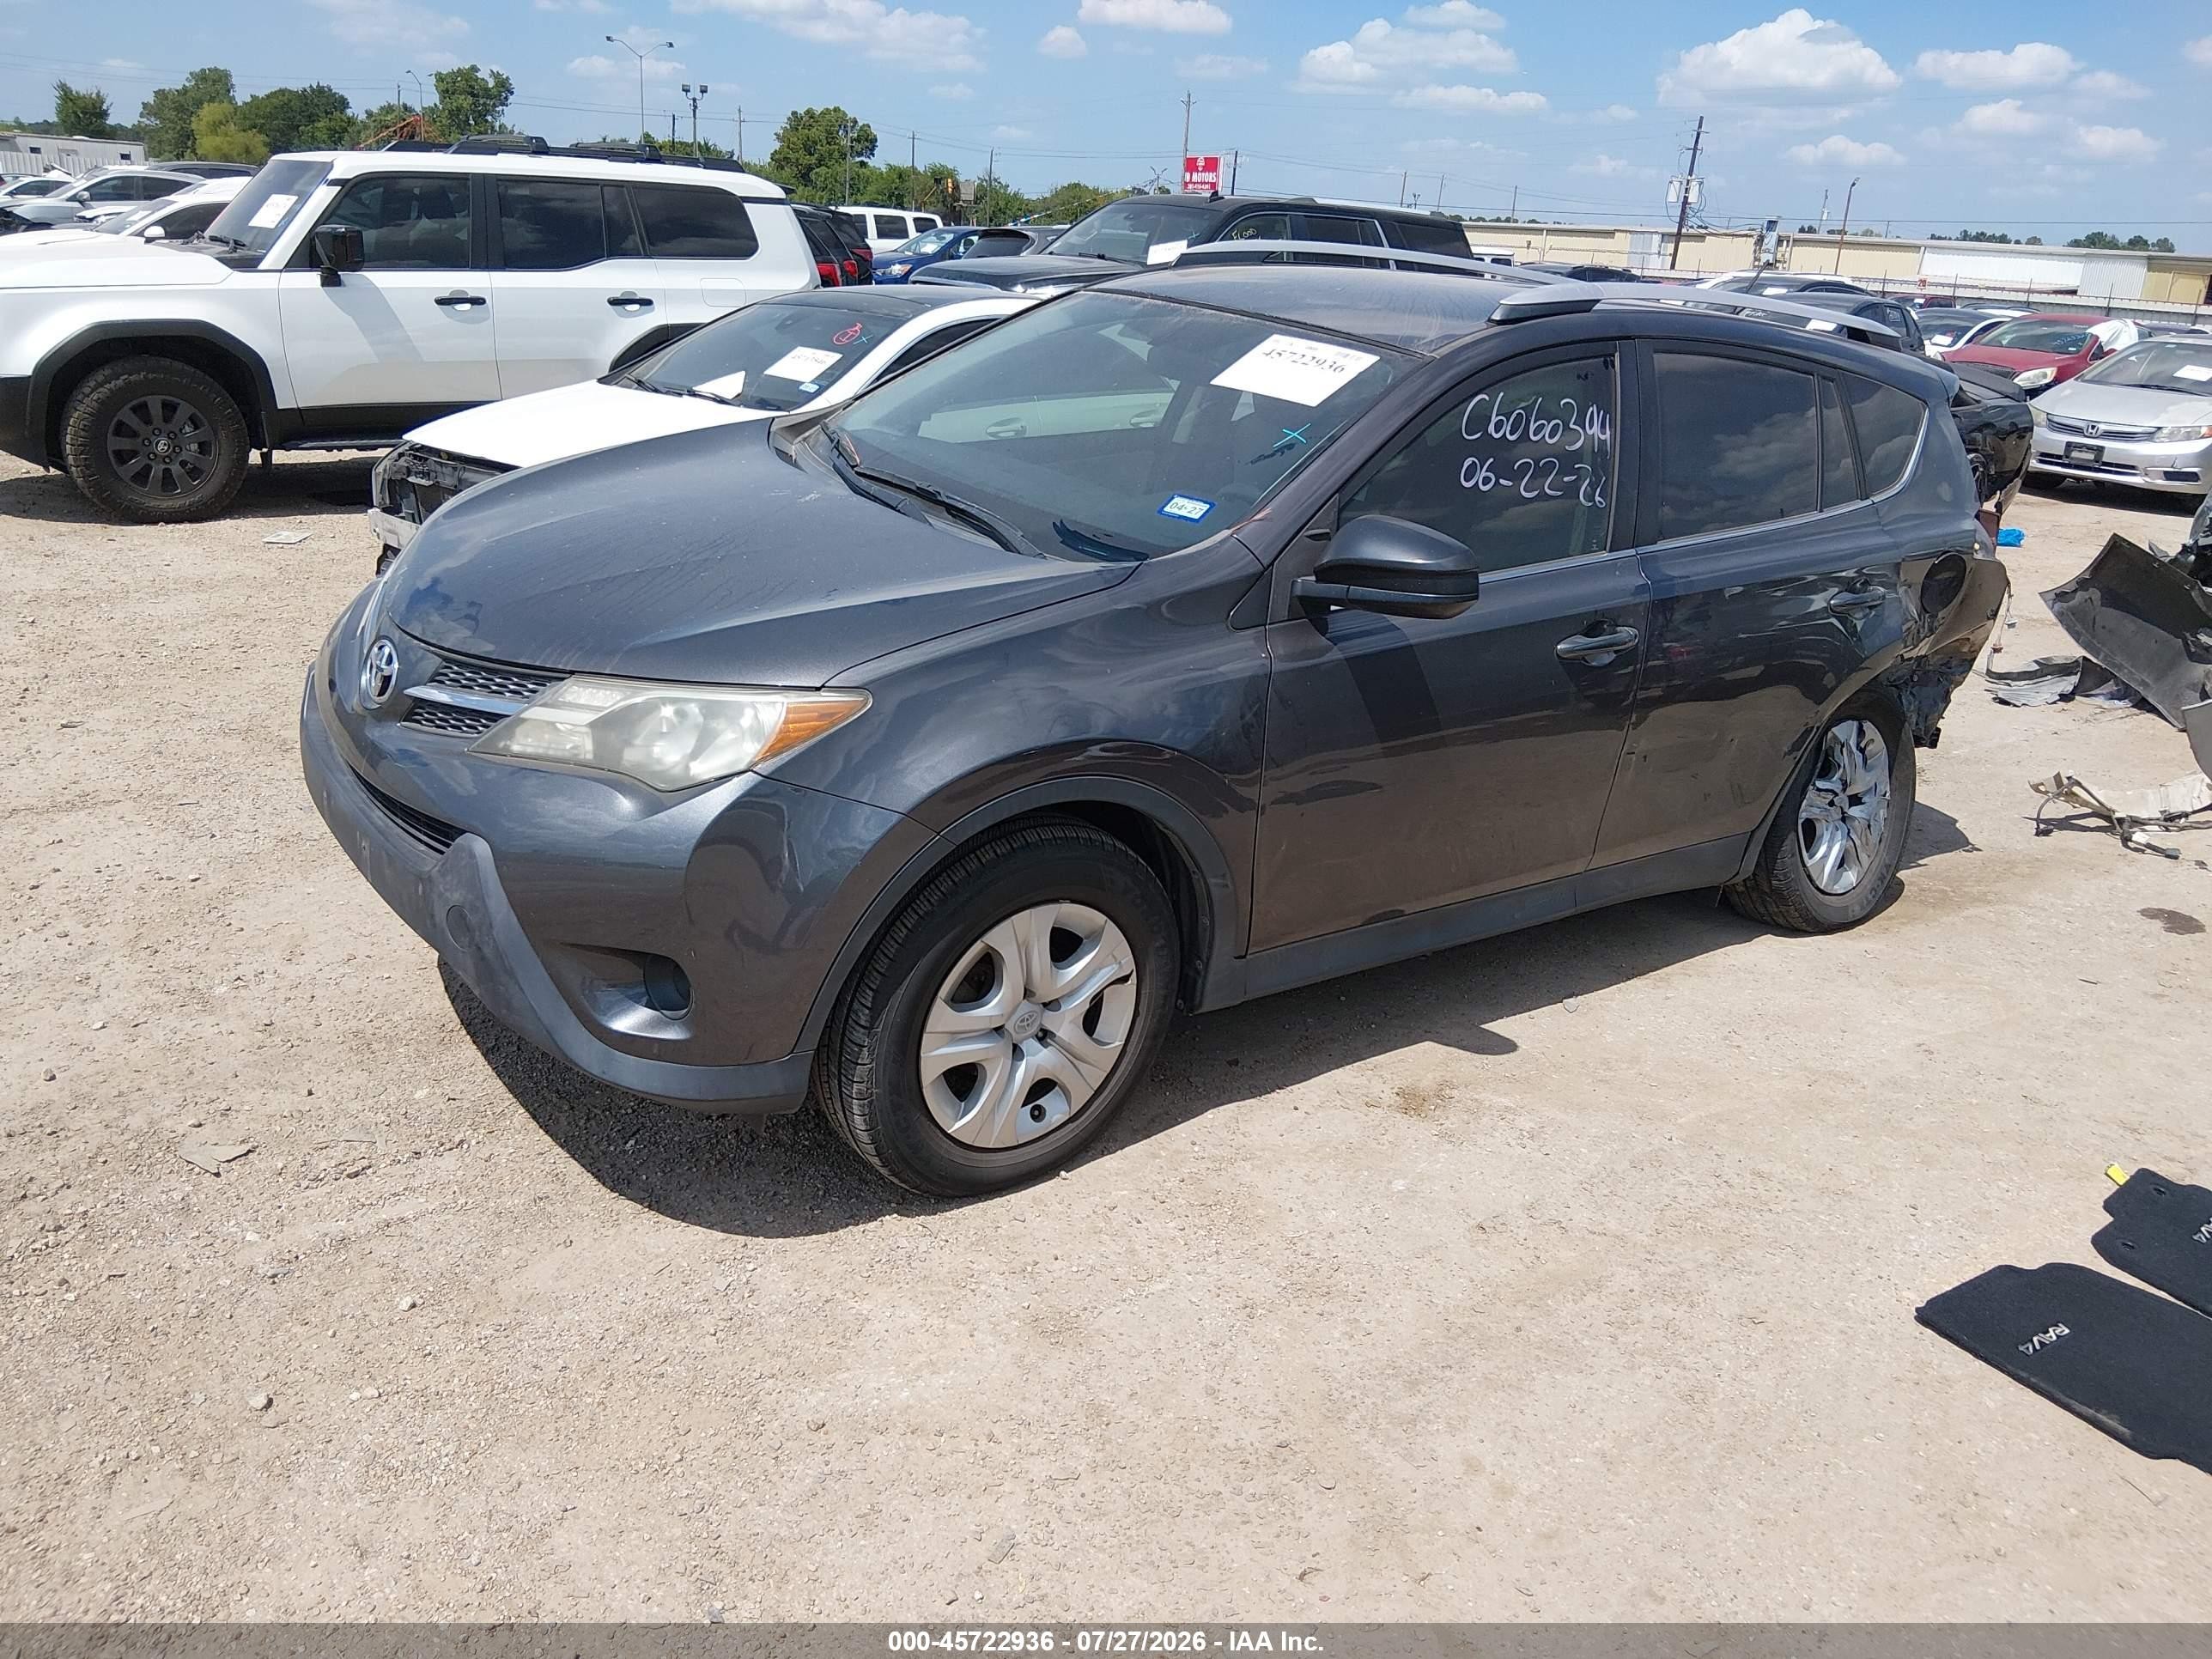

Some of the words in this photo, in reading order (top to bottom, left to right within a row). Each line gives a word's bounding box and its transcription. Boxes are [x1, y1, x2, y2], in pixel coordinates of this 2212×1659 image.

[1191, 171, 1217, 183] MOTORS
[1231, 228, 1257, 240] FLOOD
[1261, 348, 1347, 374] 45722936
[1460, 457, 1607, 508] 06-22-26
[2018, 1322, 2071, 1356] RAV4
